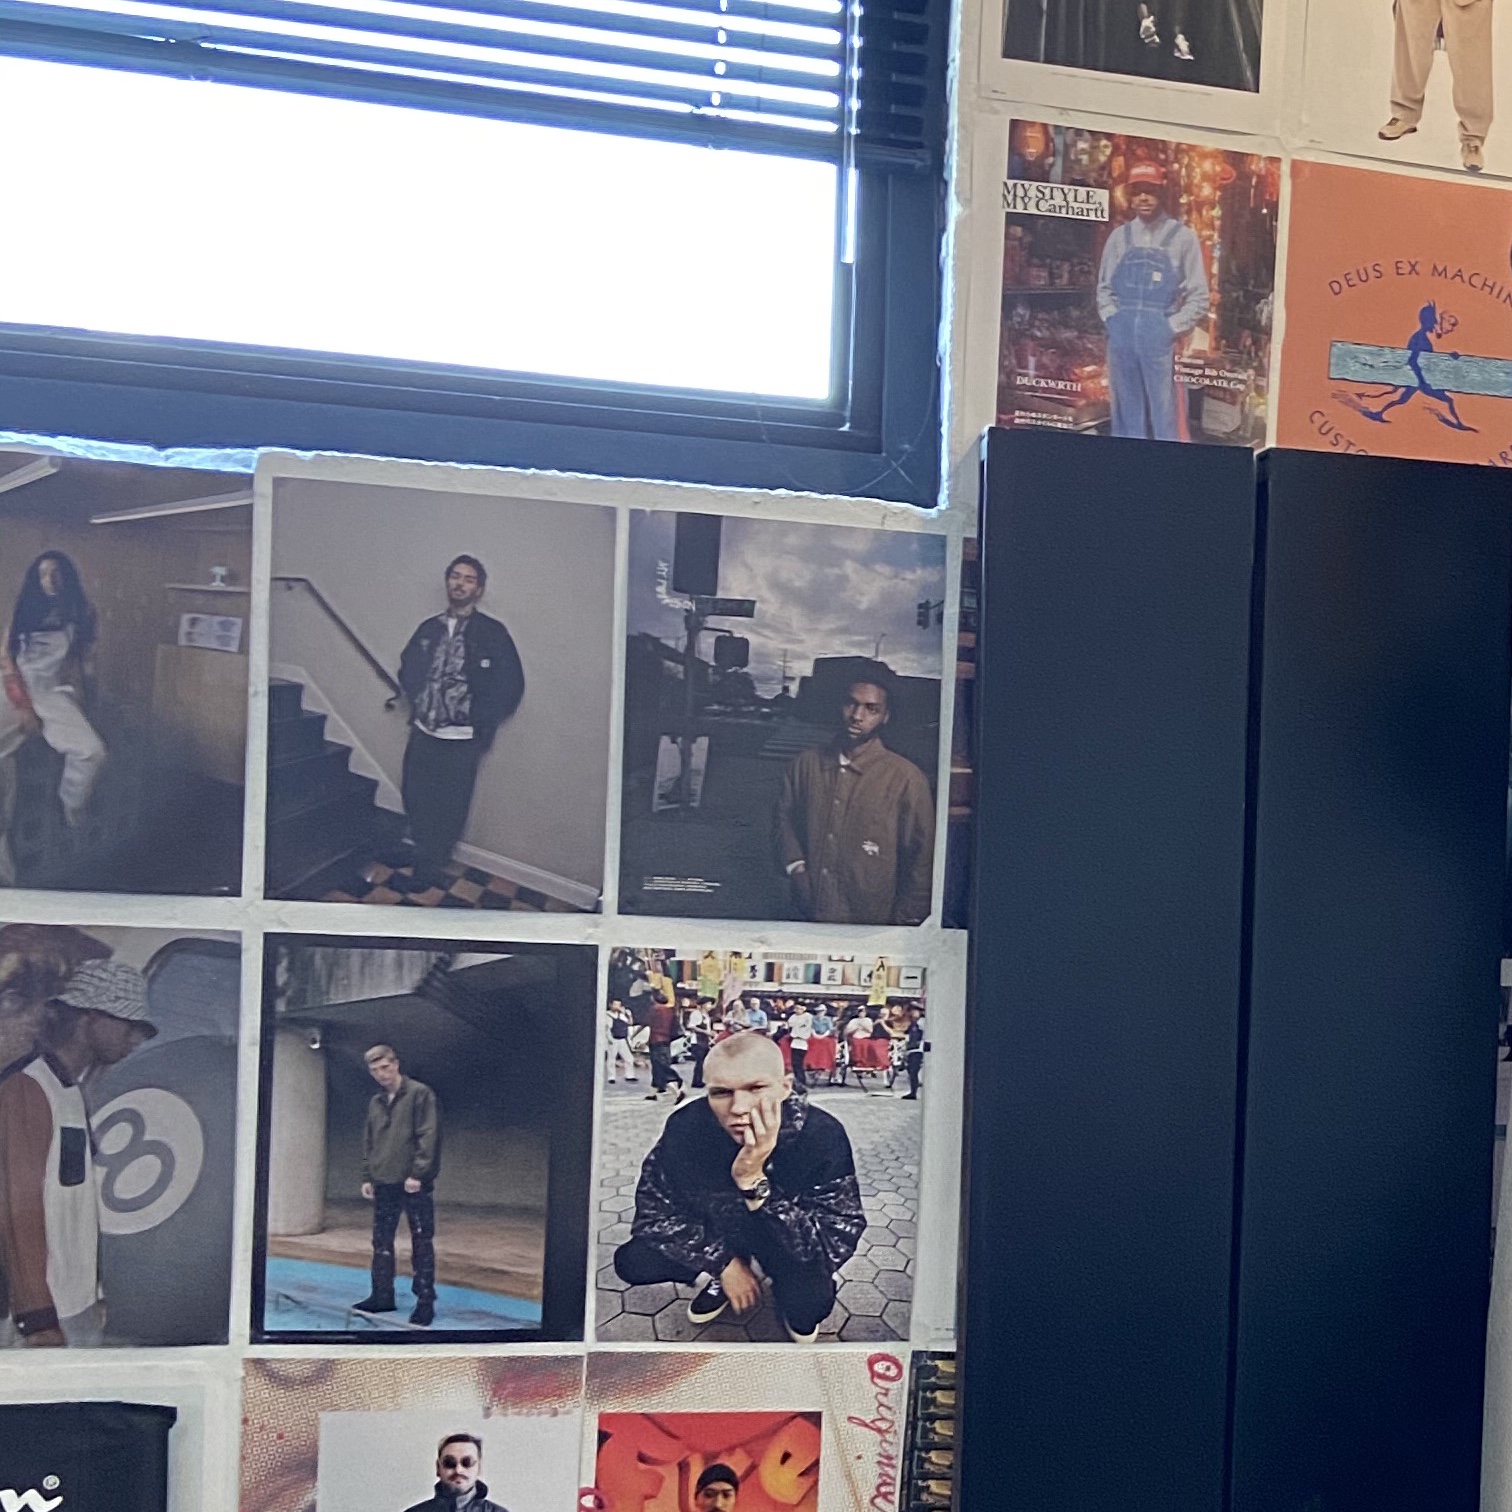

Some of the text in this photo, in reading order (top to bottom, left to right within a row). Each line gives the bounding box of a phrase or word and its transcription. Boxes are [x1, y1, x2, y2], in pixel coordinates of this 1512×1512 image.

[1002, 181, 1032, 198] MY
[1002, 195, 1106, 219] MY Carhartt
[1328, 263, 1383, 296] DEUS
[1395, 260, 1419, 276] EX
